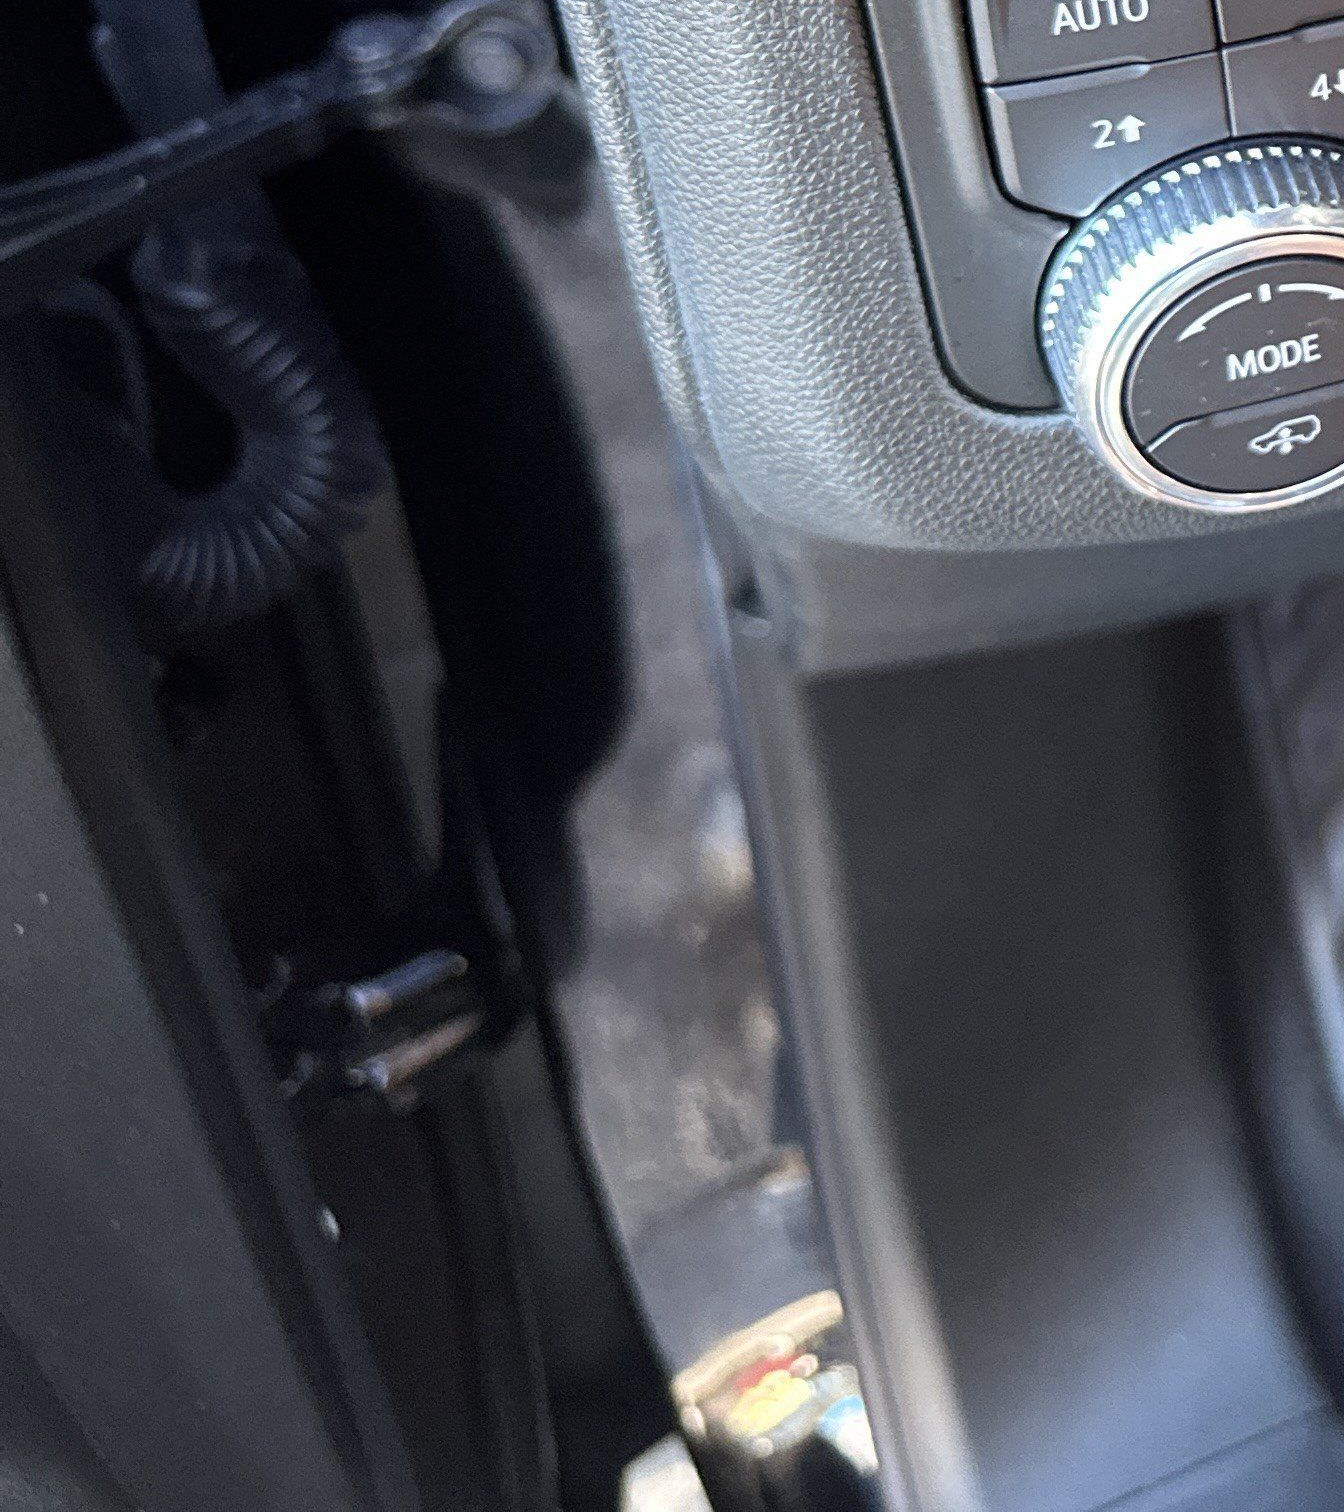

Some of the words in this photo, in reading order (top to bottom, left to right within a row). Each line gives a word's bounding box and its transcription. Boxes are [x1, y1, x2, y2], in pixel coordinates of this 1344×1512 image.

[1309, 72, 1332, 101] 4
[1091, 119, 1116, 150] 2
[1226, 333, 1322, 381] MODE
